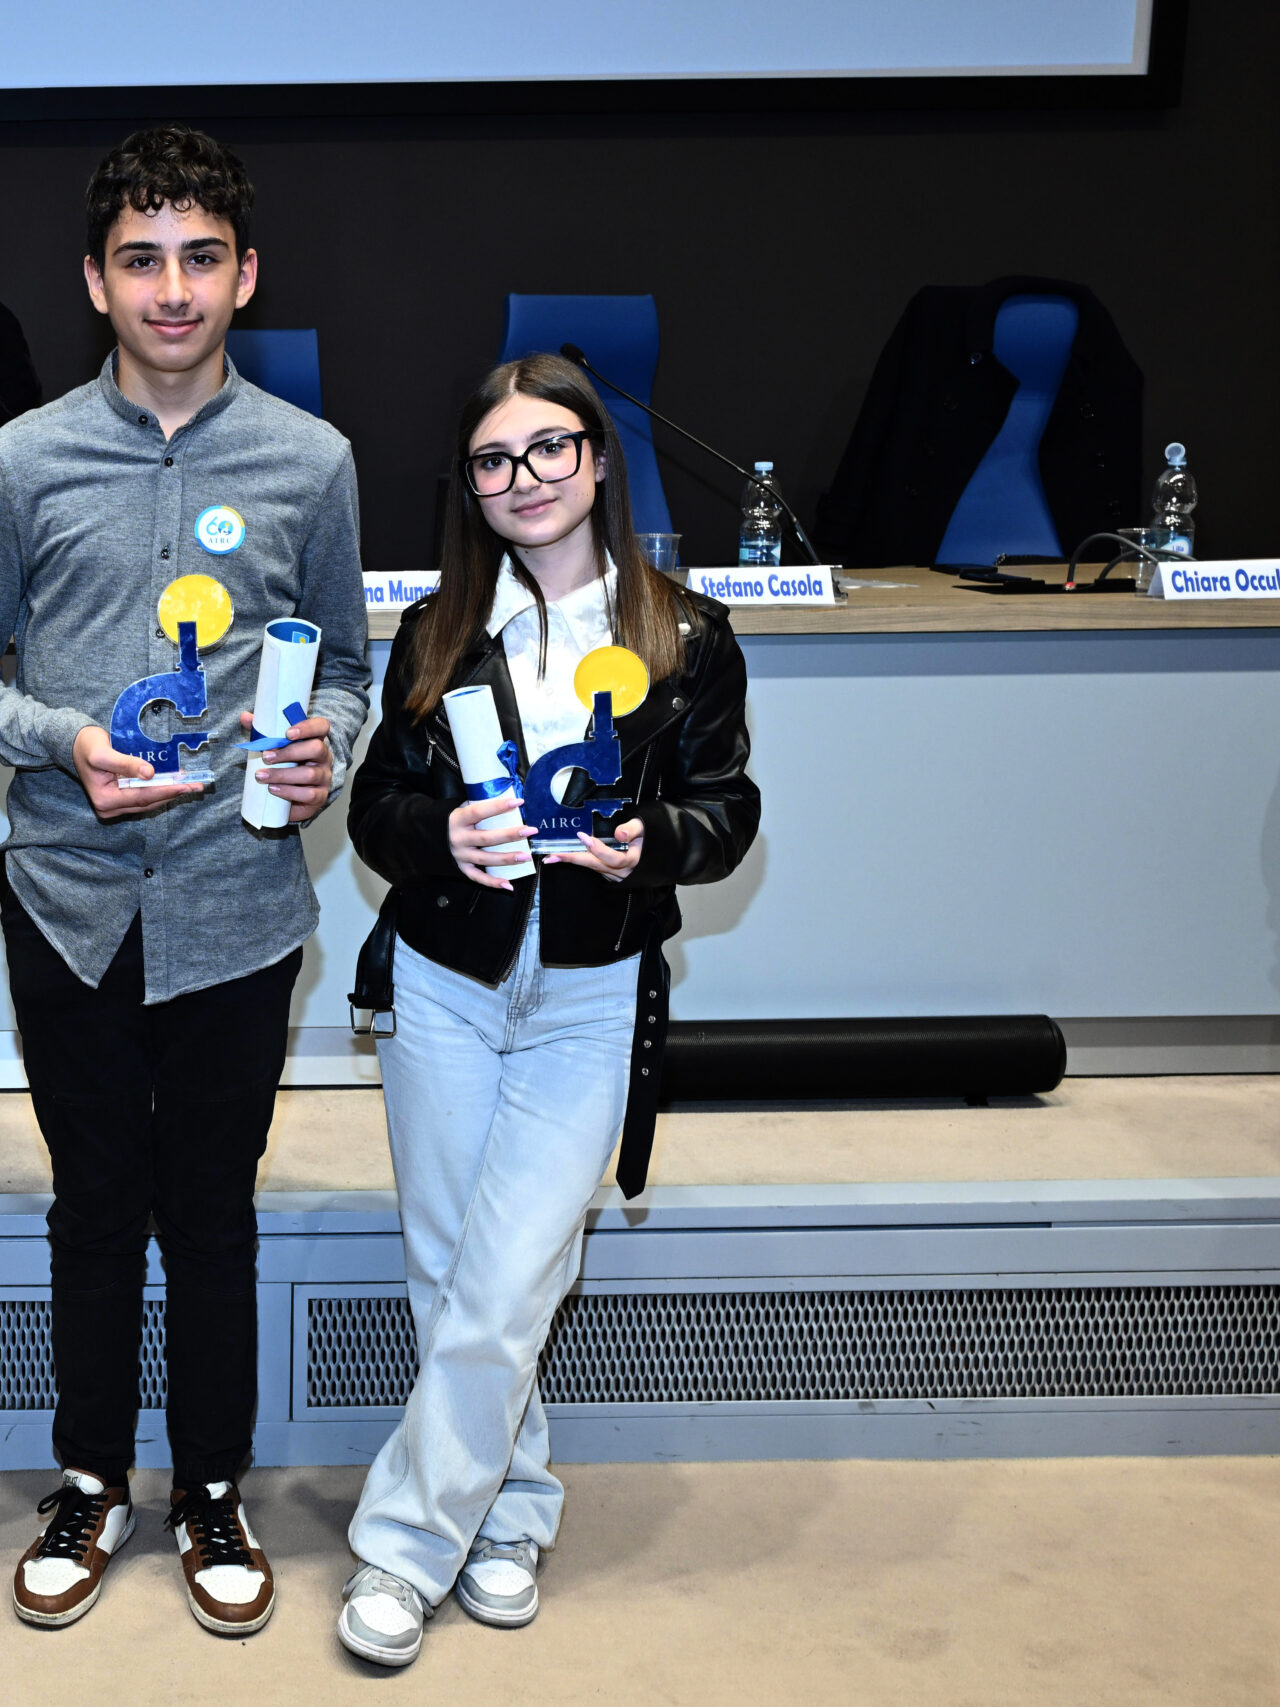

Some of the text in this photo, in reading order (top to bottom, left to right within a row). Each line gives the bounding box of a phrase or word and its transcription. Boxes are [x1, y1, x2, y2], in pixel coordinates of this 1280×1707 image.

[701, 573, 824, 598] Stefano Casola
[1171, 569, 1231, 593] Chiara
[539, 816, 581, 829] AIRC
